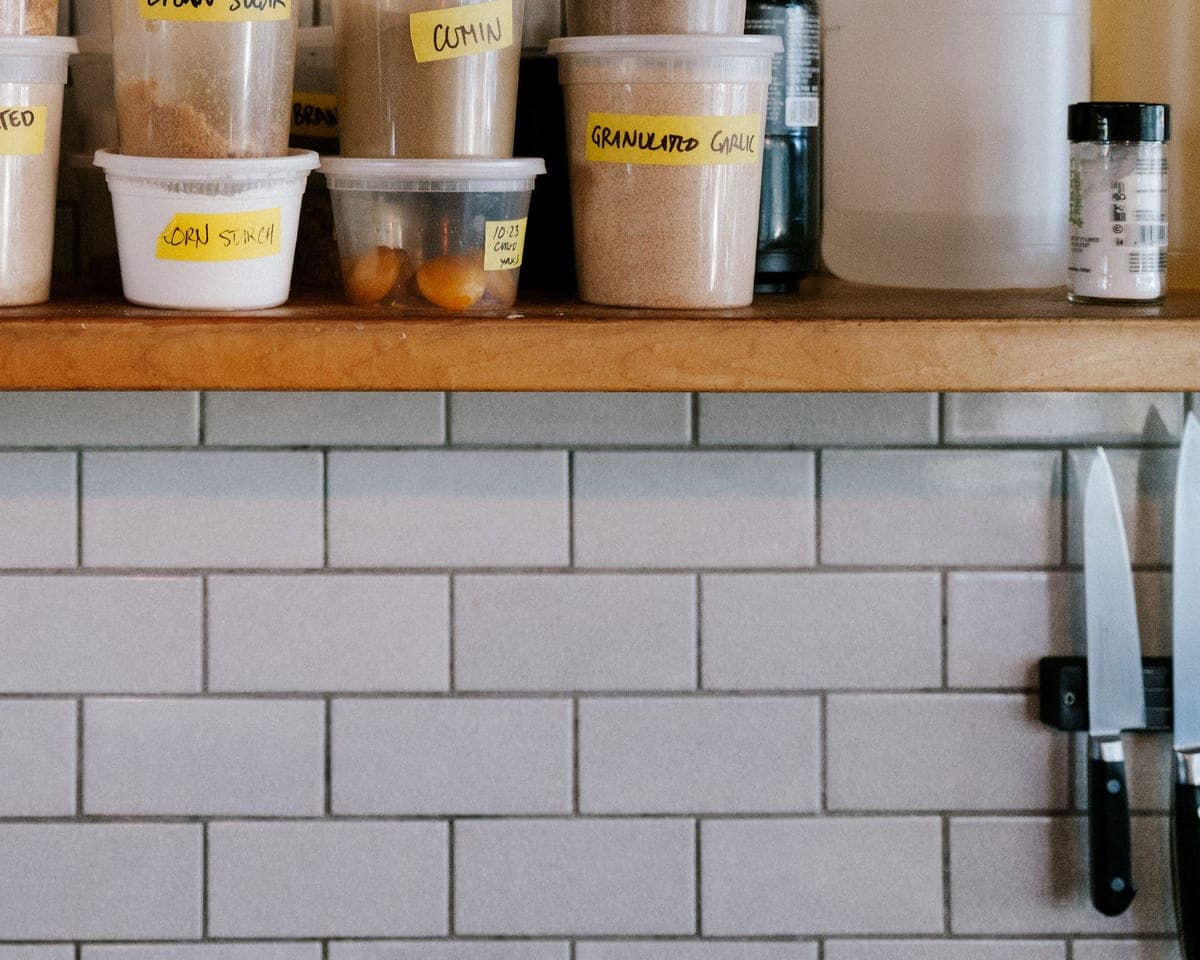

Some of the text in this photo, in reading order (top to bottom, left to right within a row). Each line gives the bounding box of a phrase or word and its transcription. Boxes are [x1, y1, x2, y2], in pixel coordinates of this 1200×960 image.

[433, 17, 502, 52] CUMIN
[591, 125, 756, 155] GRANULATED GARLIC
